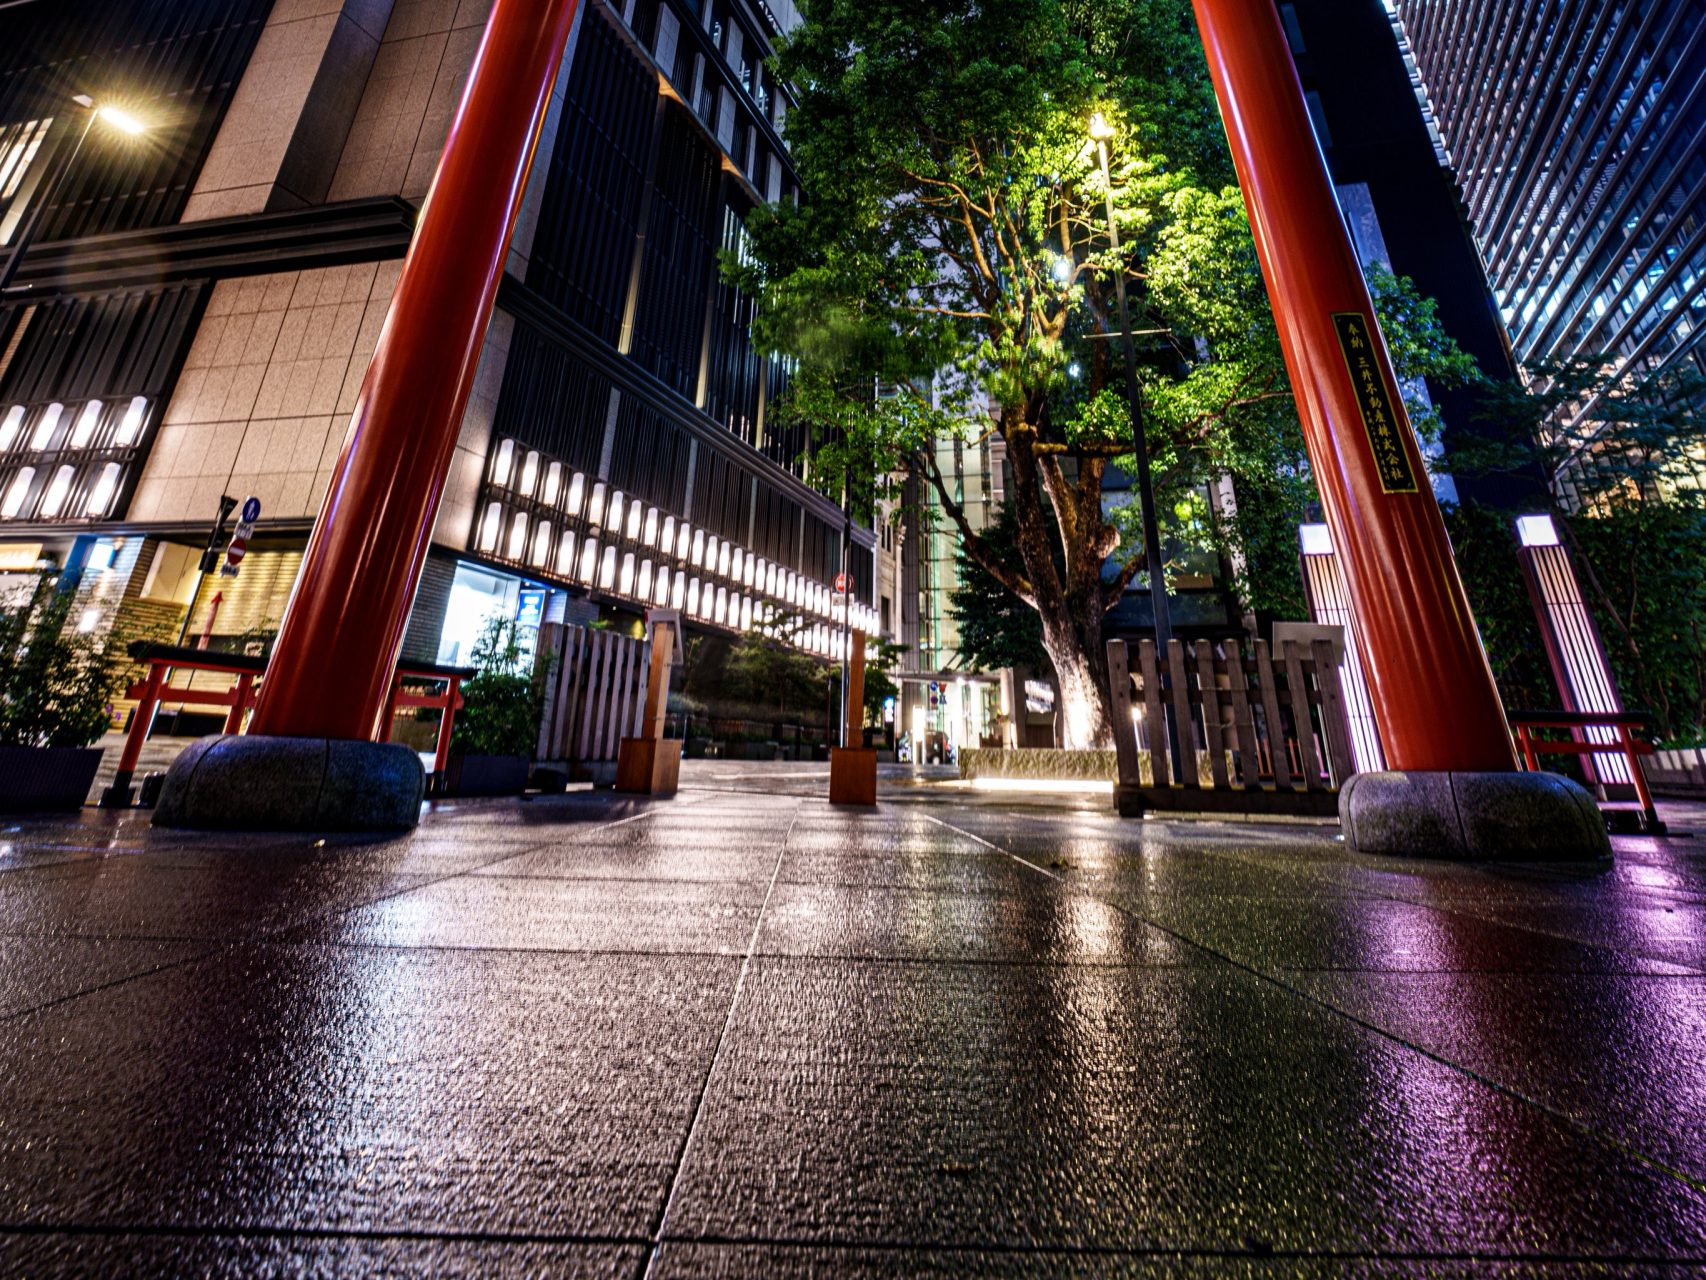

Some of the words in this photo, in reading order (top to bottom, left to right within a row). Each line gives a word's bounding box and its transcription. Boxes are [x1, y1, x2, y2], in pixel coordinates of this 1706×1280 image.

[1358, 358, 1404, 480] 三井不動産株式会社
